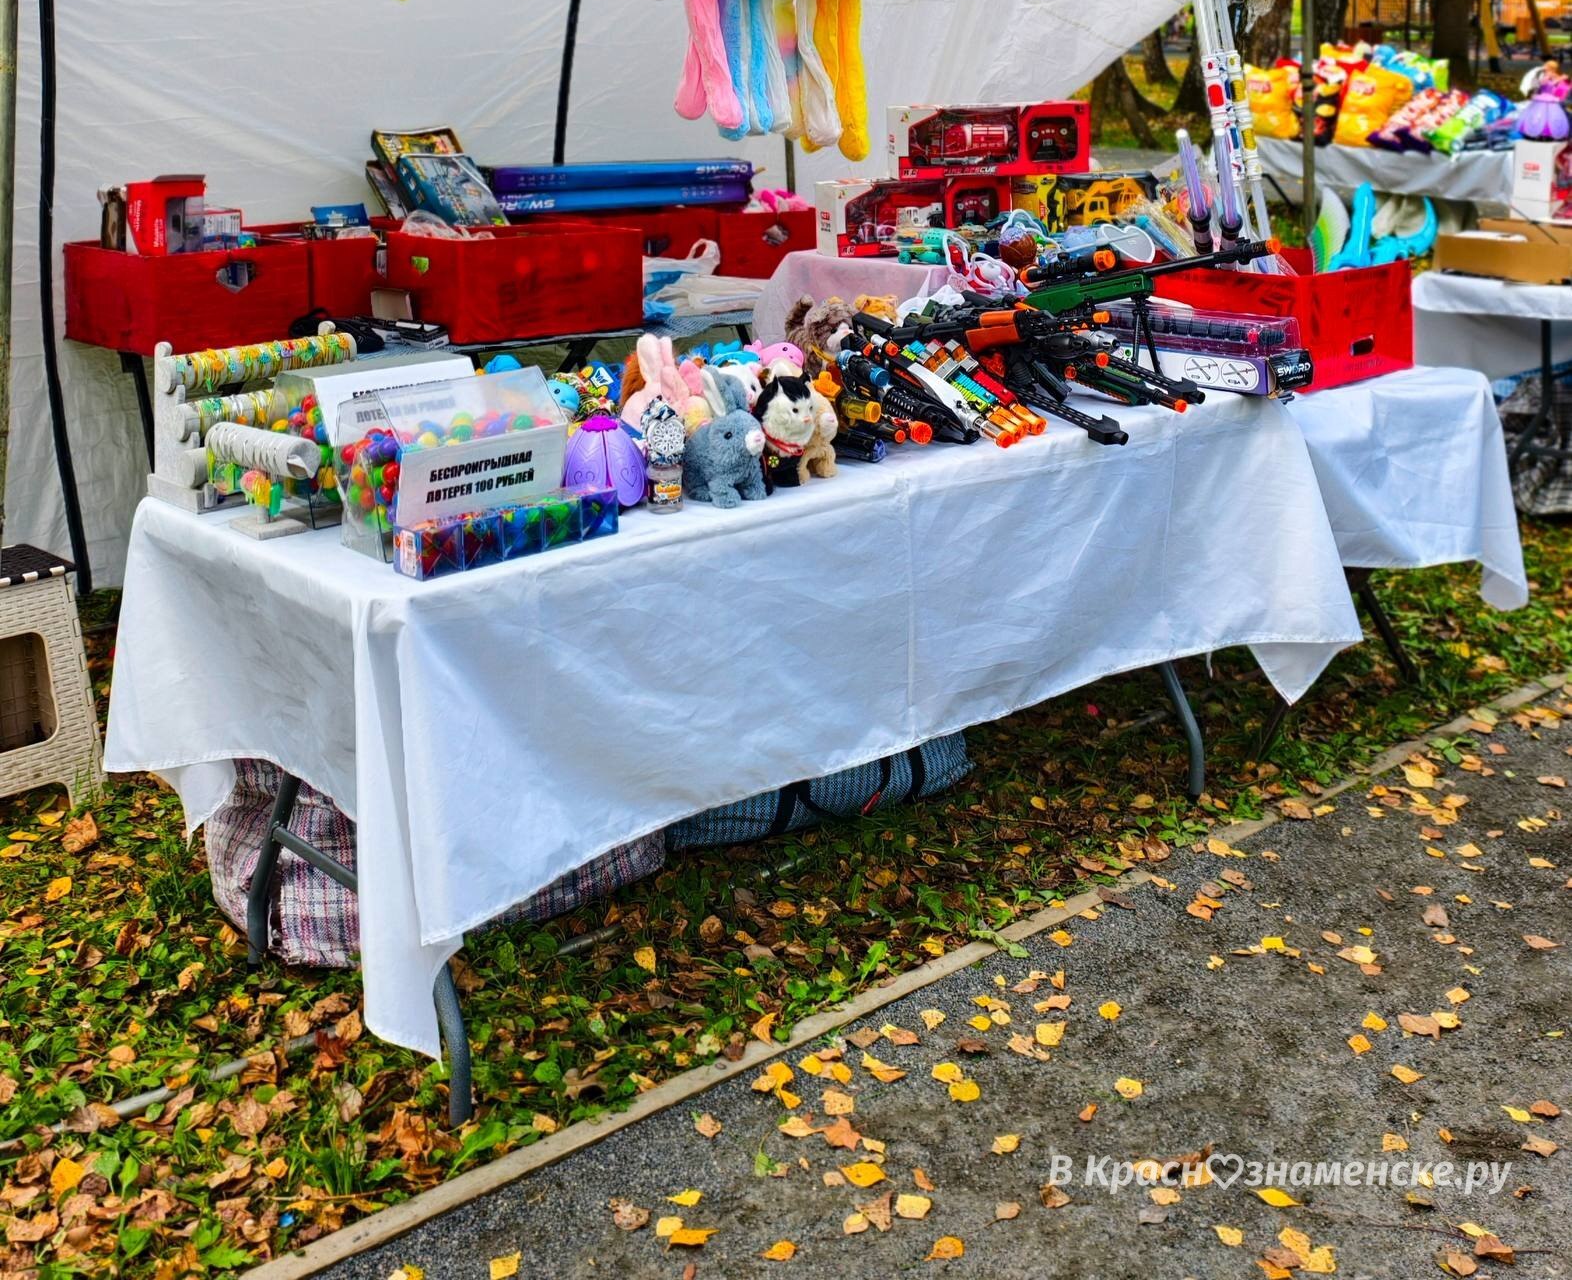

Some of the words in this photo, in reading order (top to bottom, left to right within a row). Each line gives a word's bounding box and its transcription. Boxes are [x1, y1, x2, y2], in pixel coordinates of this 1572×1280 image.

[1277, 362, 1311, 377] SWORD
[429, 449, 533, 483] БЕСПРОИГРЫШНАЯ
[425, 482, 474, 504] ЛОТЕРЕЯ
[475, 478, 494, 493] 100
[495, 467, 535, 489] РУБЛЕЙ
